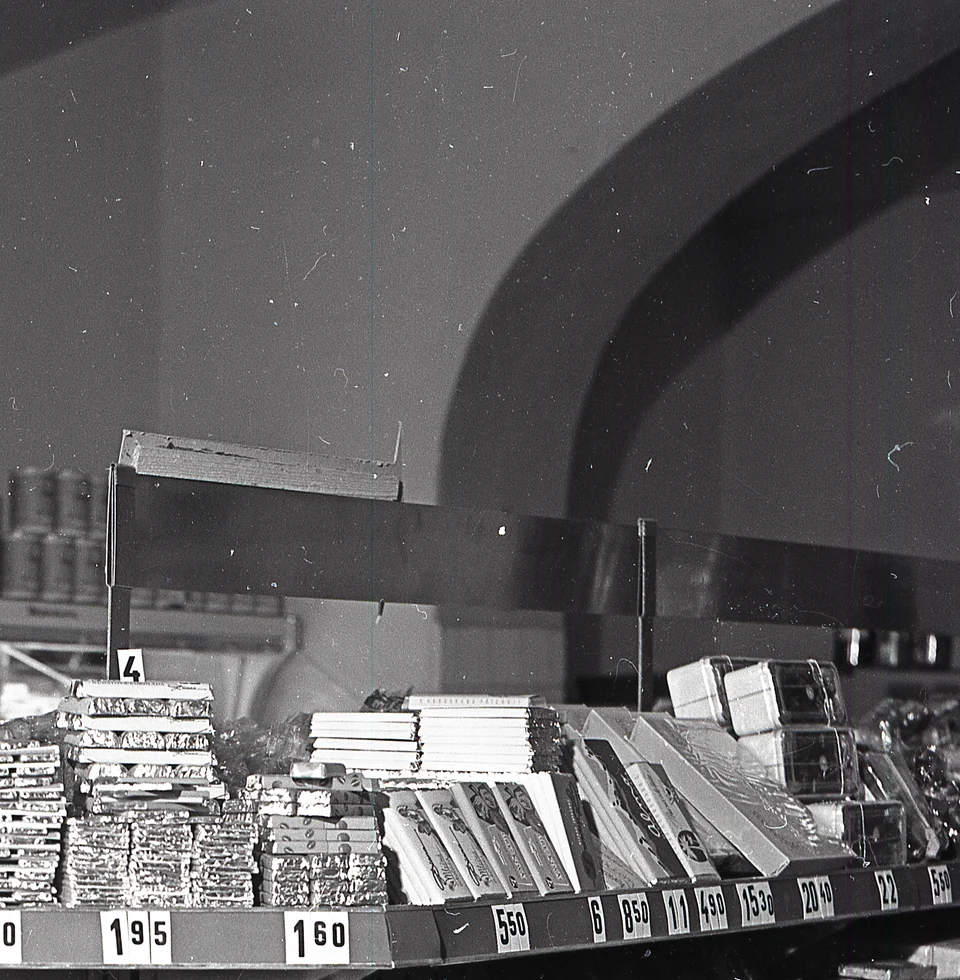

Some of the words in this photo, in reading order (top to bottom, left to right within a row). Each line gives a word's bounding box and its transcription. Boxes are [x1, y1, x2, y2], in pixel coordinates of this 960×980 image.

[123, 656, 141, 682] 4
[878, 874, 897, 904] 22
[590, 900, 603, 935] 6
